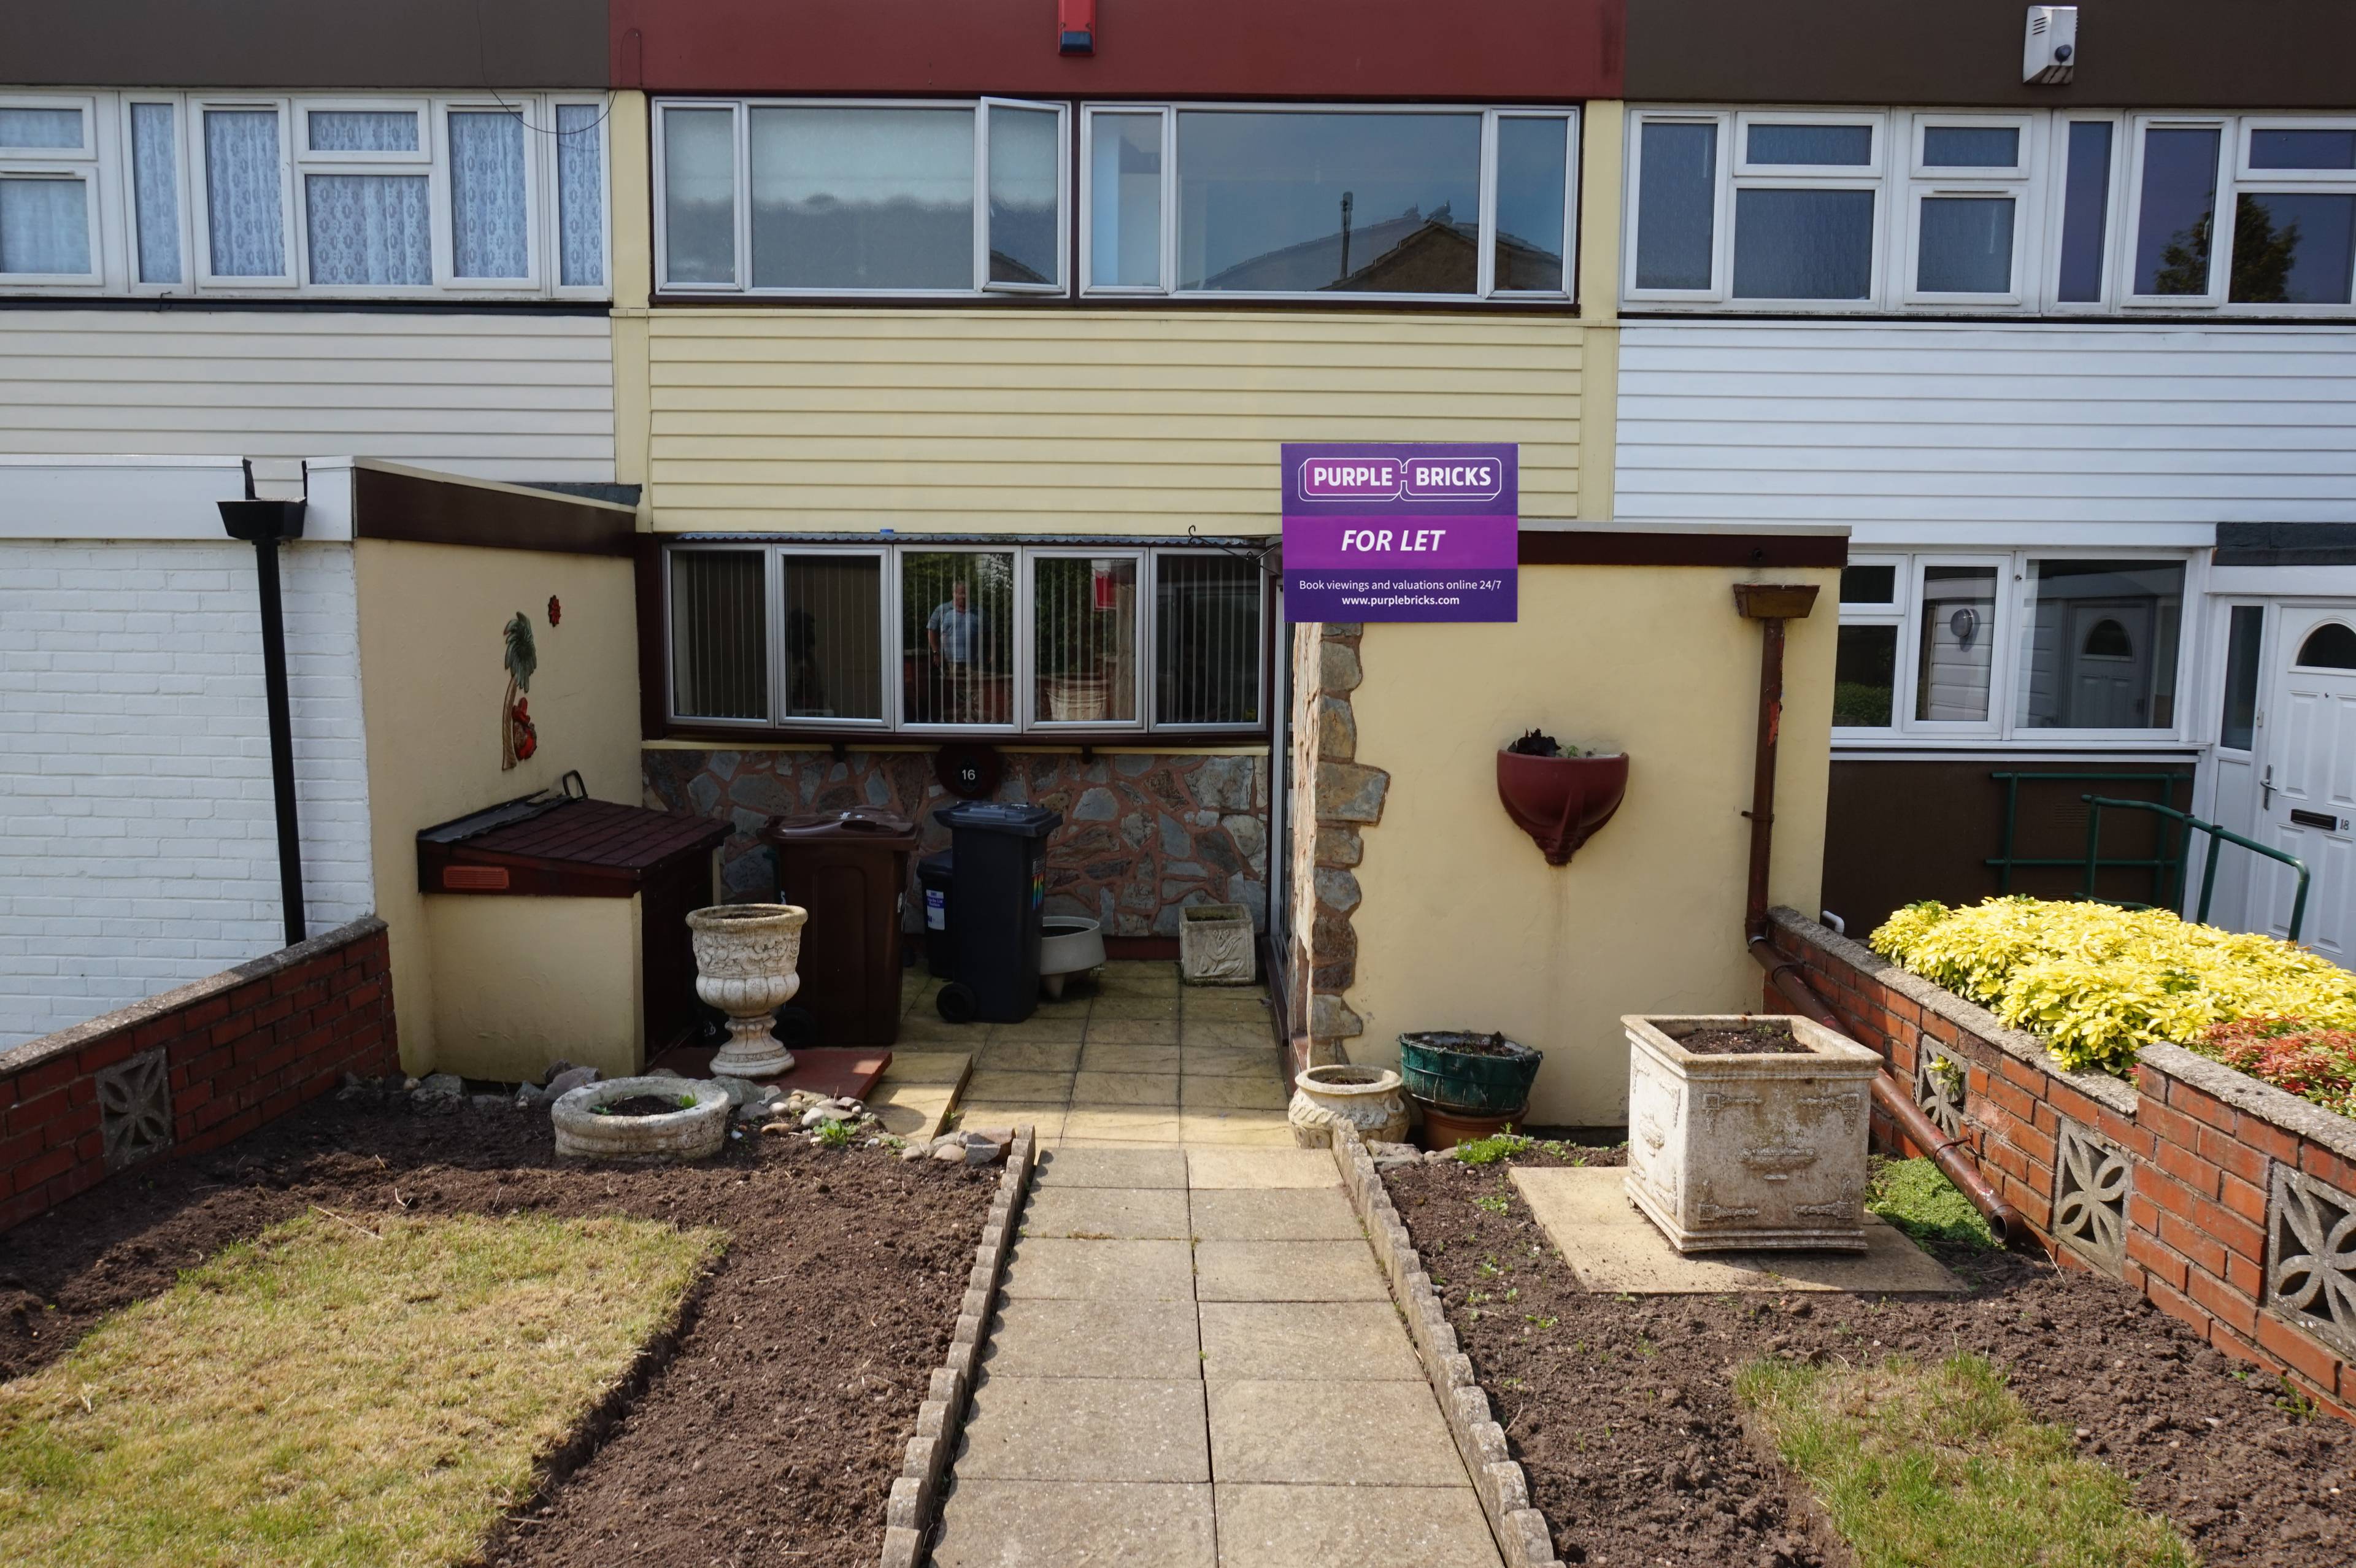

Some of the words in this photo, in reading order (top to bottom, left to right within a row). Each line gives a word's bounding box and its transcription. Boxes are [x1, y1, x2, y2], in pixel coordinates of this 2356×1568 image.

[1314, 467, 1393, 486] PURPLE
[1416, 467, 1492, 486] BRICKS
[1341, 529, 1393, 551] FOR
[1400, 529, 1446, 551] LET
[1299, 580, 1325, 590] Book
[1326, 580, 1369, 593] viewings
[1371, 580, 1390, 590] and
[1392, 580, 1444, 590] valuations
[1446, 580, 1477, 590] online
[1479, 580, 1501, 591] 24/7
[1341, 595, 1460, 607] www.purplebricks.com
[962, 769, 976, 780] 16
[2339, 819, 2349, 831] 18
